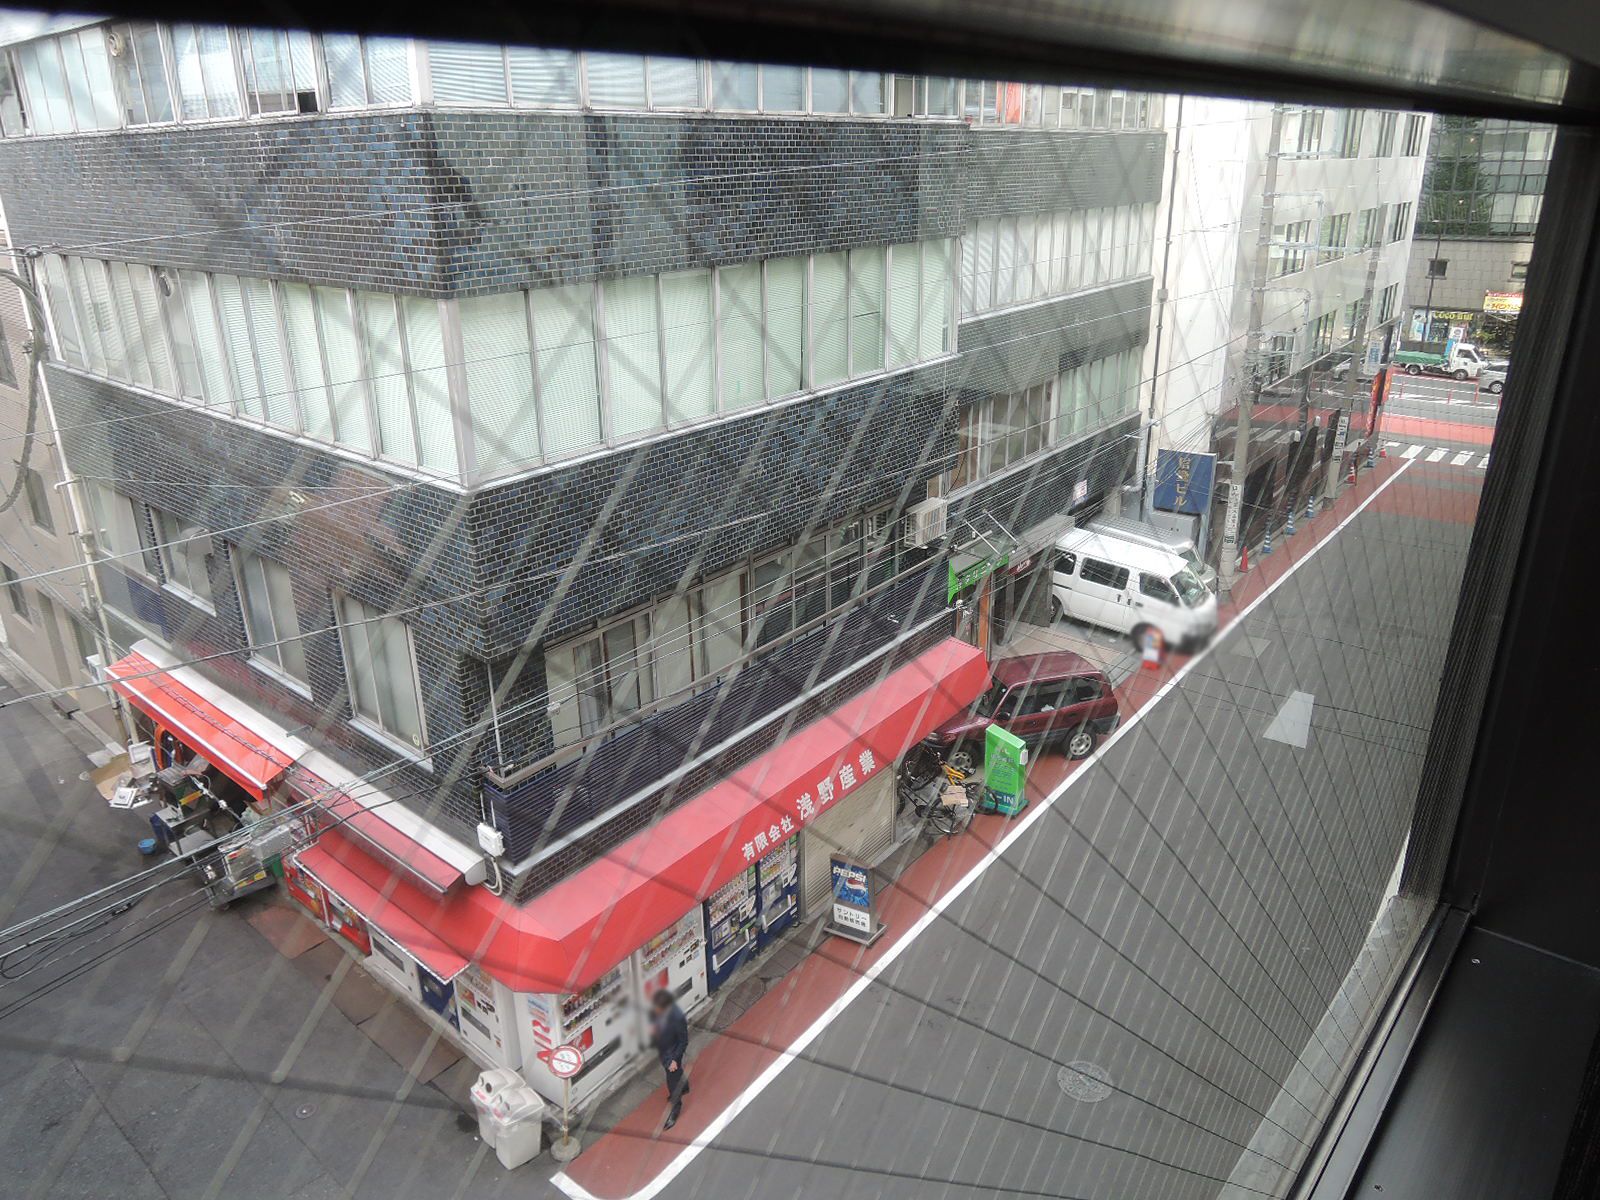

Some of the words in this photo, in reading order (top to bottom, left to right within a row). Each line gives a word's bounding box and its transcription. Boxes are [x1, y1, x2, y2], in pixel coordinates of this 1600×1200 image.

[832, 866, 867, 883] PEPSI
[837, 907, 867, 921] サントリー
